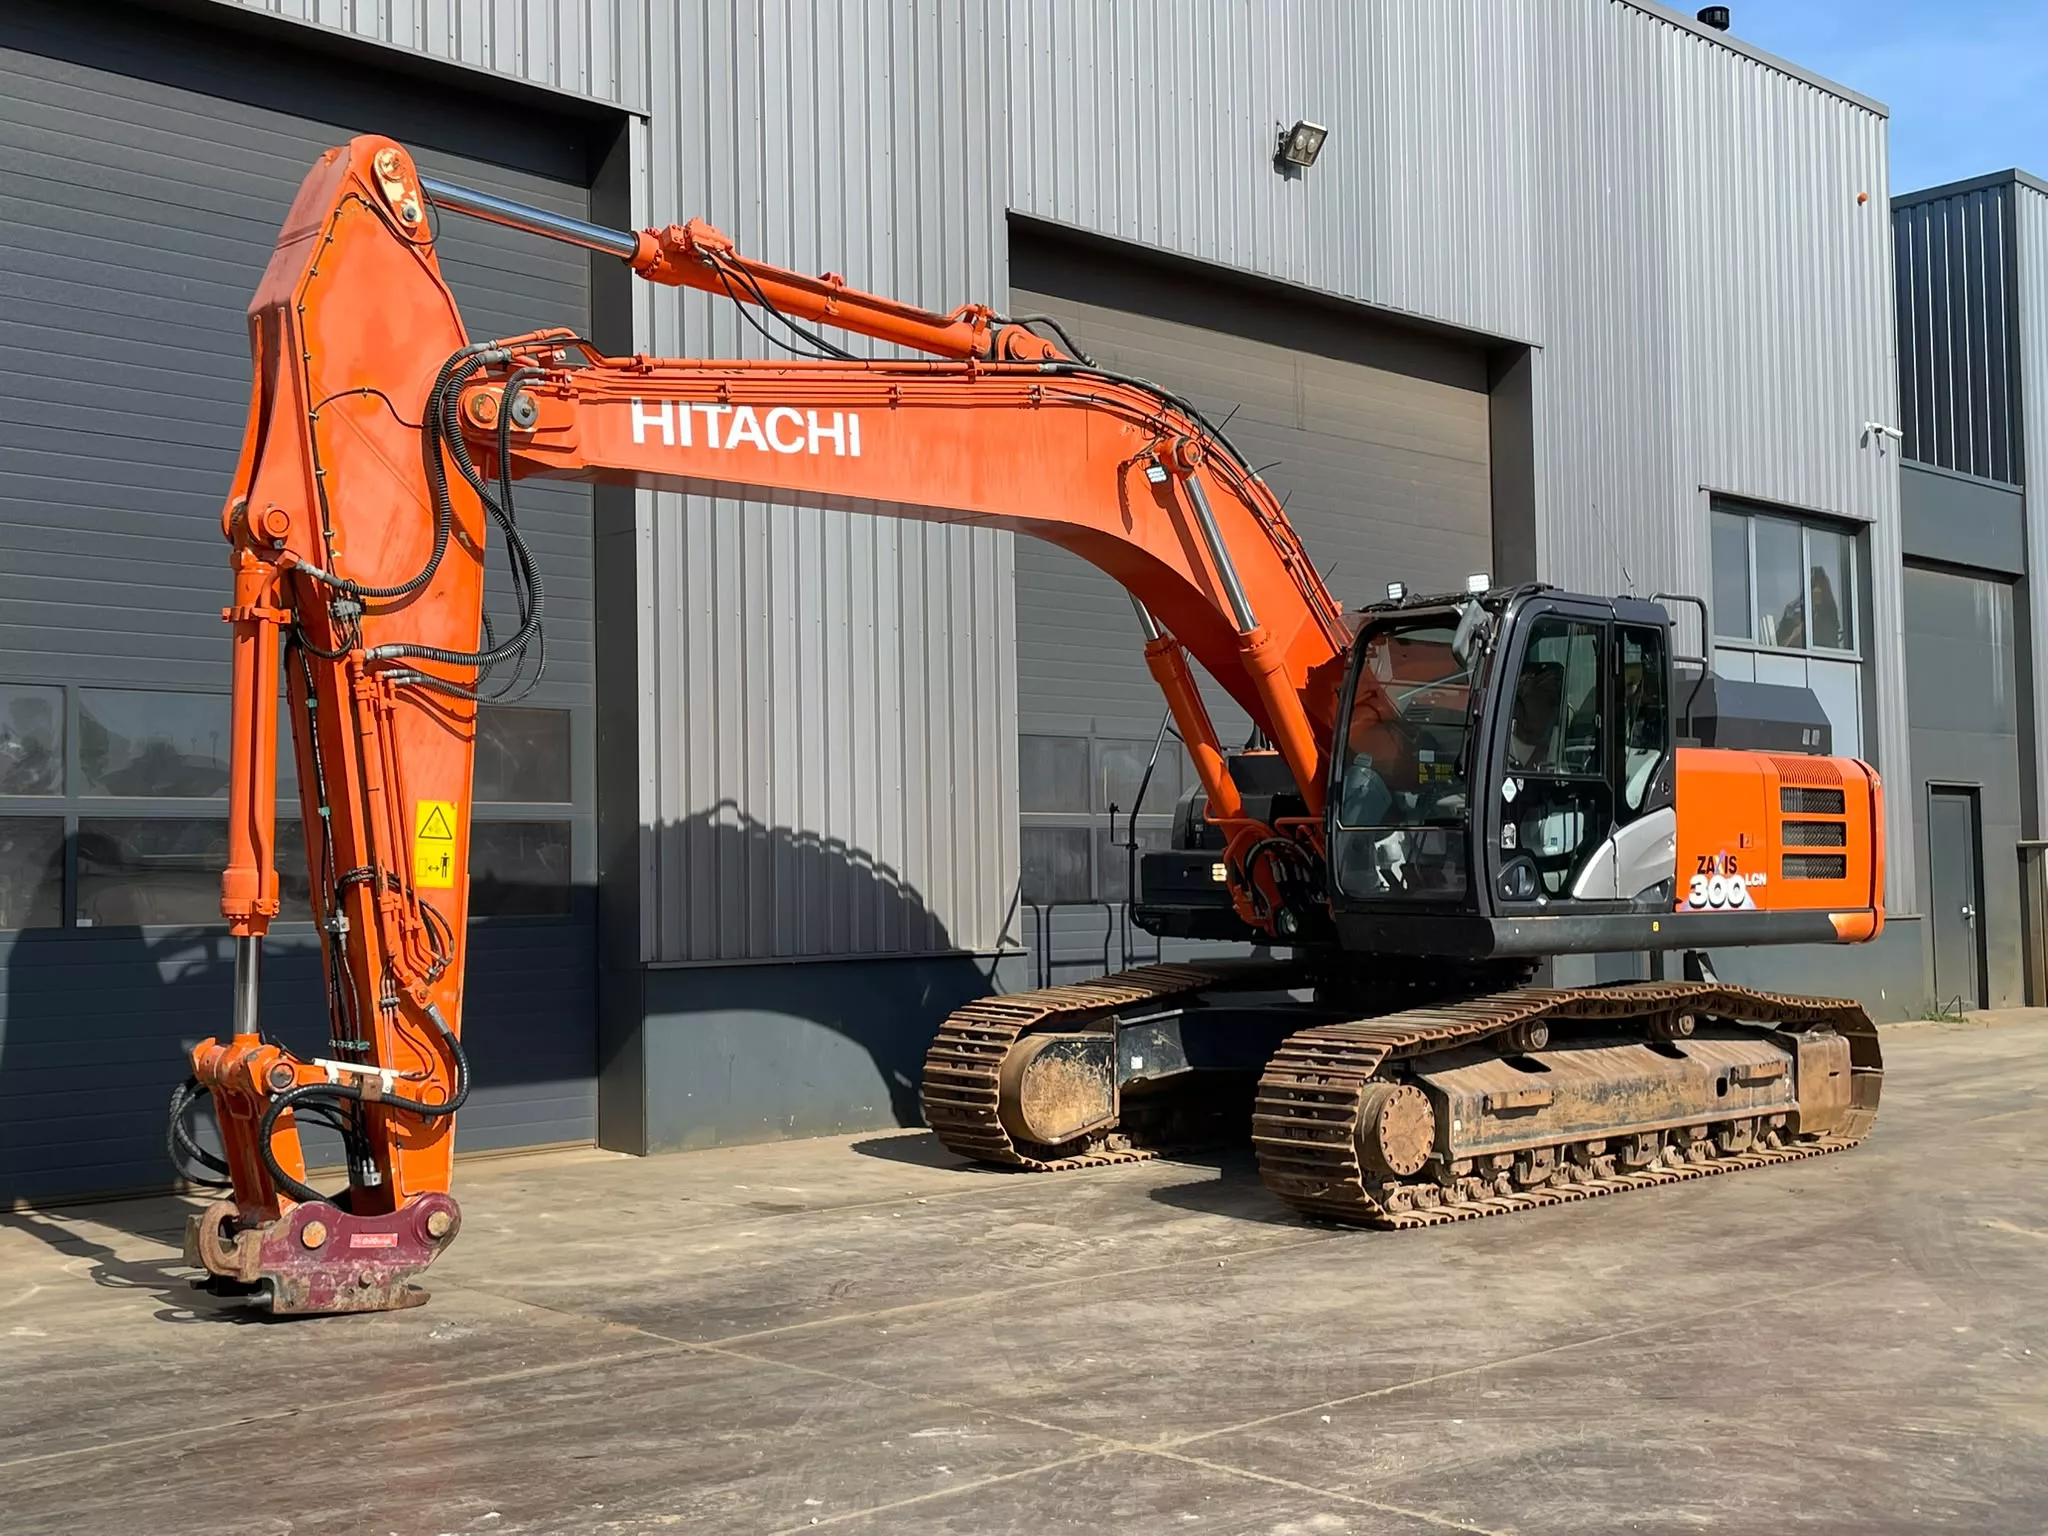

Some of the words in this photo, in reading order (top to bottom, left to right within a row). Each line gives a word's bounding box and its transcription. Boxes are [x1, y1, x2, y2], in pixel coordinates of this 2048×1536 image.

[631, 397, 861, 457] HITACHI
[1697, 854, 1737, 874] ZAXIS
[1688, 874, 1745, 908] 300
